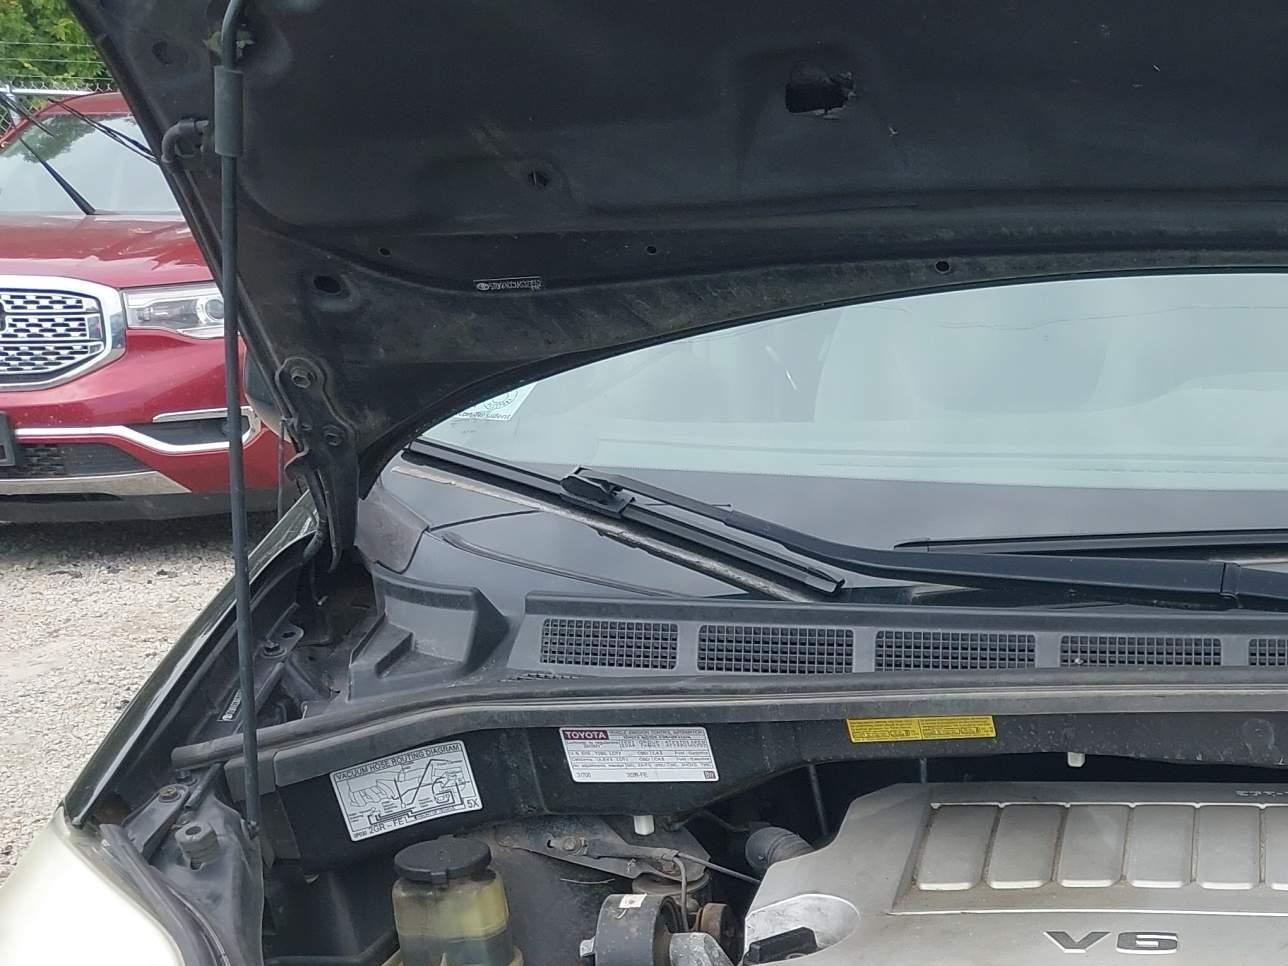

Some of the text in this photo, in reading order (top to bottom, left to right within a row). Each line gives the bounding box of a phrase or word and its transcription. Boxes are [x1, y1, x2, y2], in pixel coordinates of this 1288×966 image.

[564, 731, 607, 739] TOYOTA
[337, 744, 460, 780] VACUUM HOSE ROUTING DIAGRAM
[466, 799, 480, 809] 5X
[1043, 930, 1179, 955] V6
